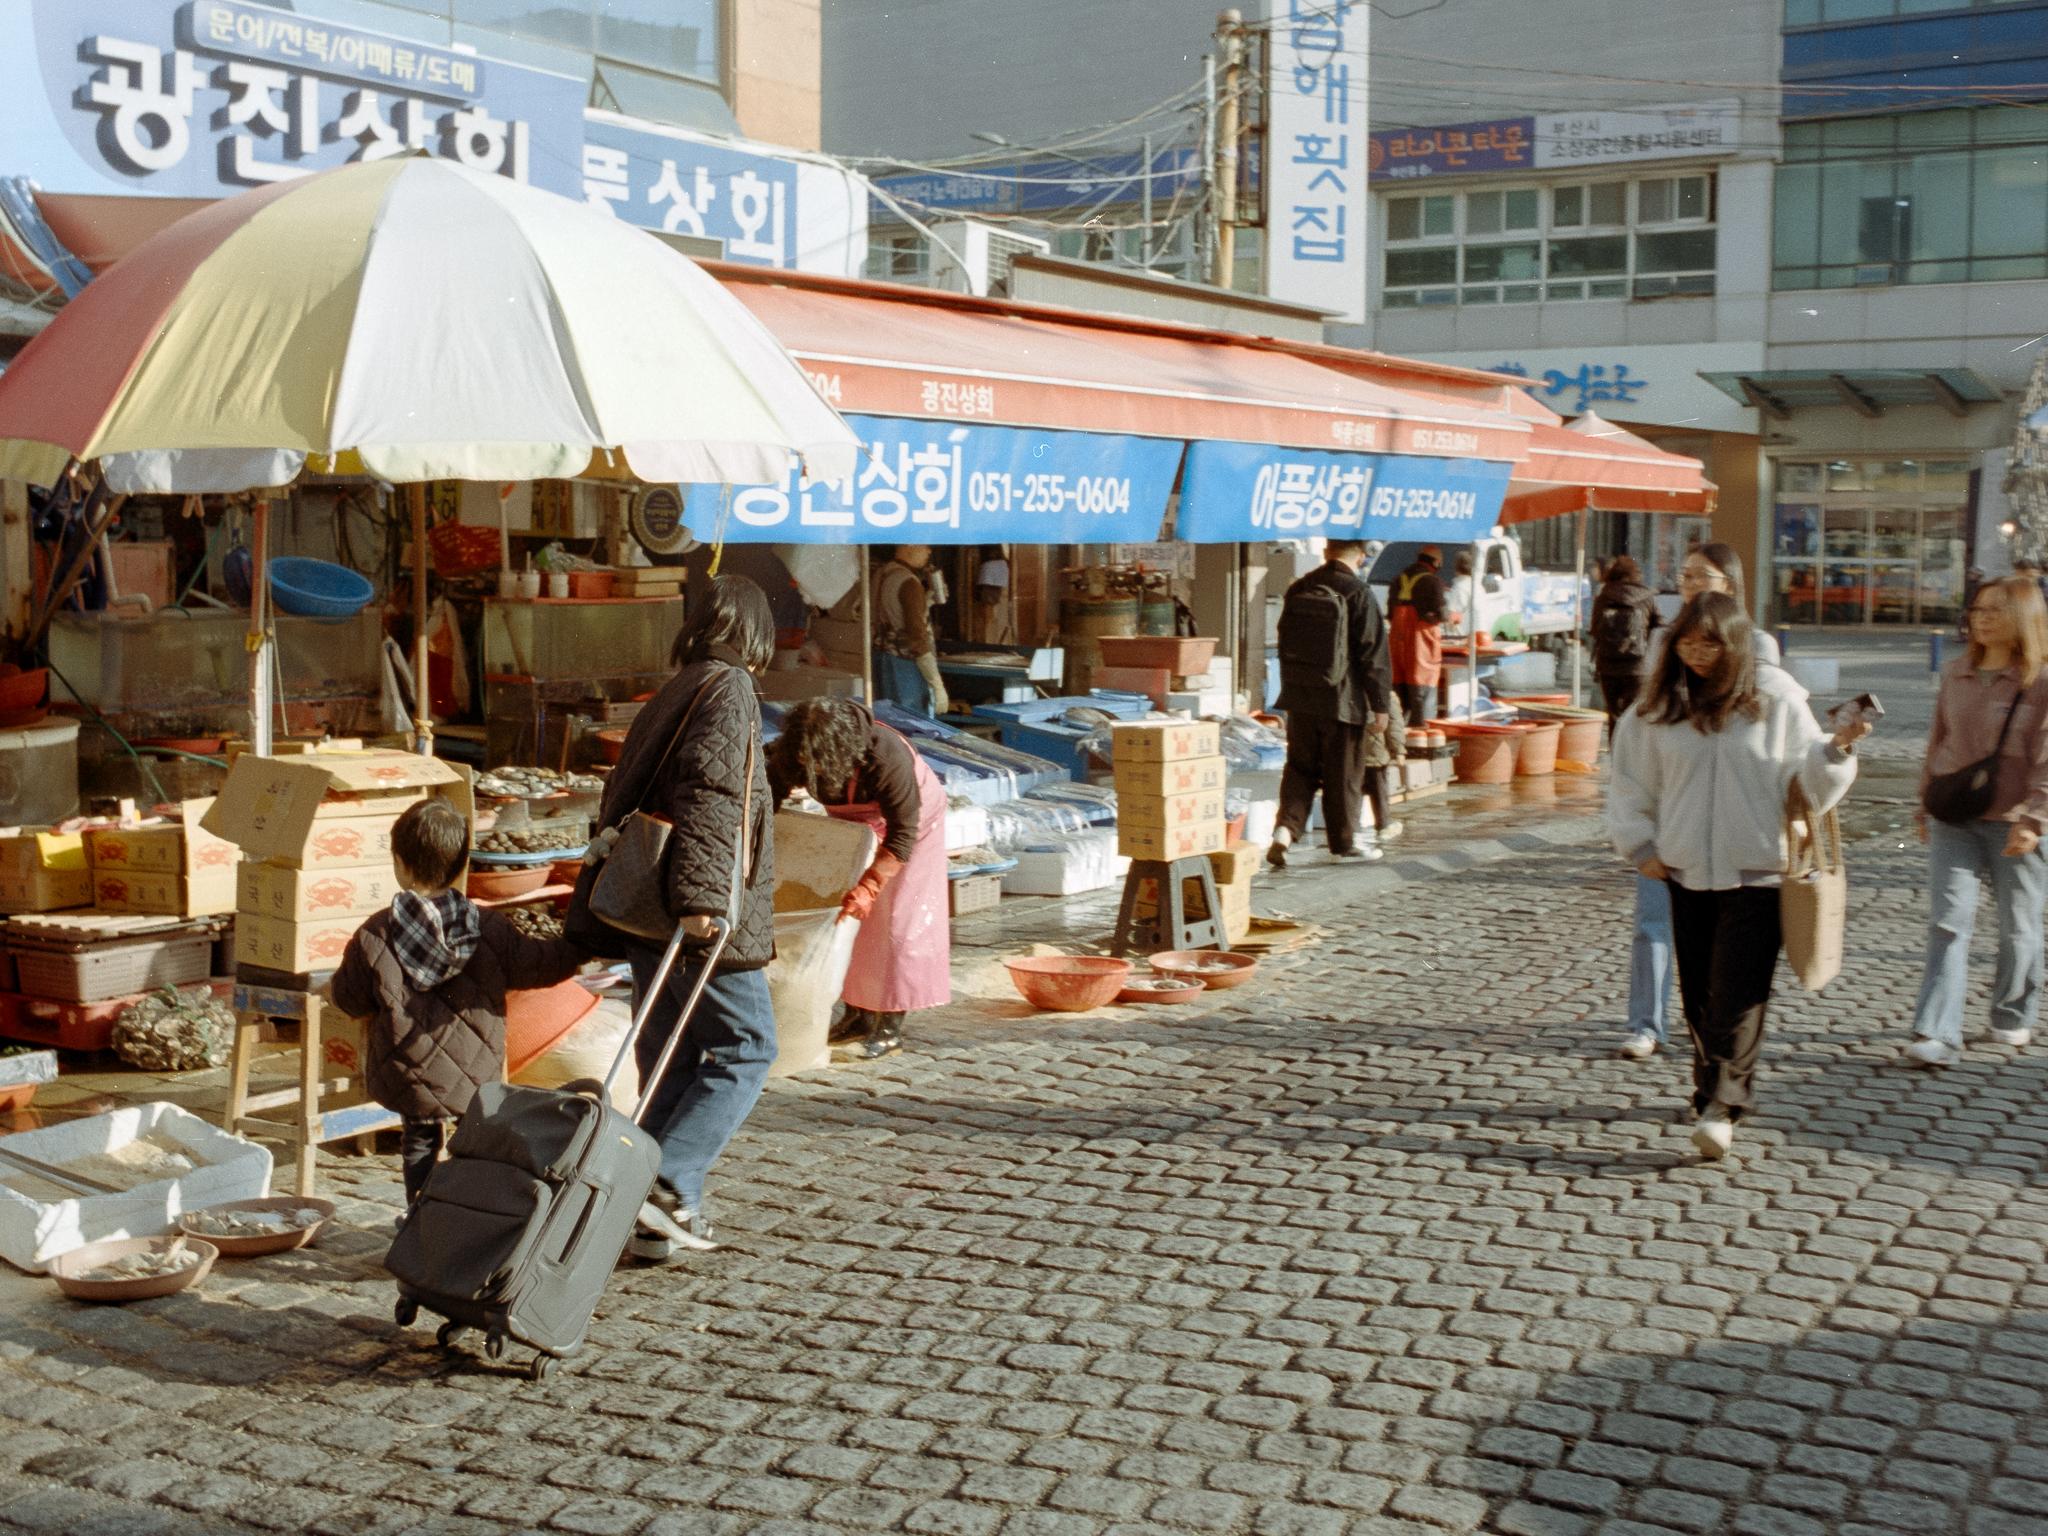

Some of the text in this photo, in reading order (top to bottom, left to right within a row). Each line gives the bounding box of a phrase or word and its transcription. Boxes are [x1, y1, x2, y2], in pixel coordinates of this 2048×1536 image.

[86, 35, 529, 185] 광진상회
[1389, 125, 1530, 166] 라이콘타운
[920, 379, 995, 418] 광진상회
[968, 471, 1131, 515] 051-255-0604
[1369, 486, 1477, 520] 051-253-0614
